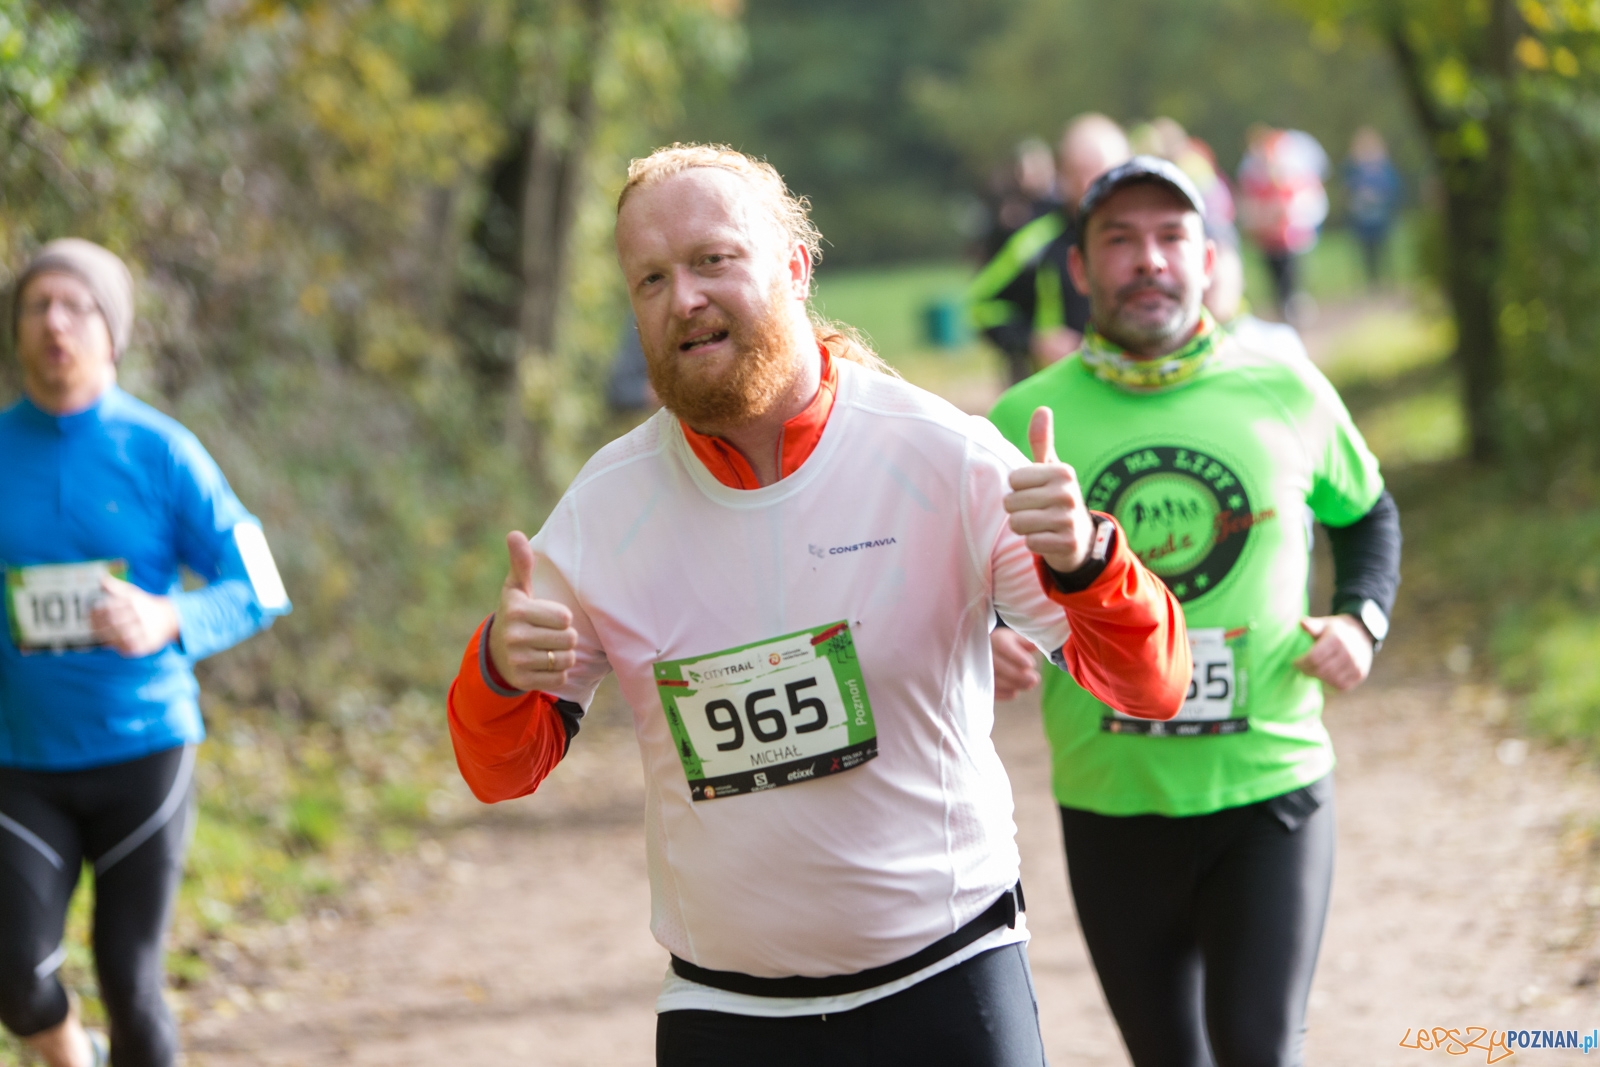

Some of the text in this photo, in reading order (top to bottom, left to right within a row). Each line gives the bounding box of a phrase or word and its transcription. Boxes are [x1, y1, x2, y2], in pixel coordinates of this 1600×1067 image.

[1123, 449, 1162, 474] MA
[1172, 449, 1236, 492] LIPY
[828, 537, 897, 555] CONSTRAVIA
[704, 676, 829, 752] 965
[844, 678, 867, 726] Poznań
[750, 744, 803, 767] MICHAŁ
